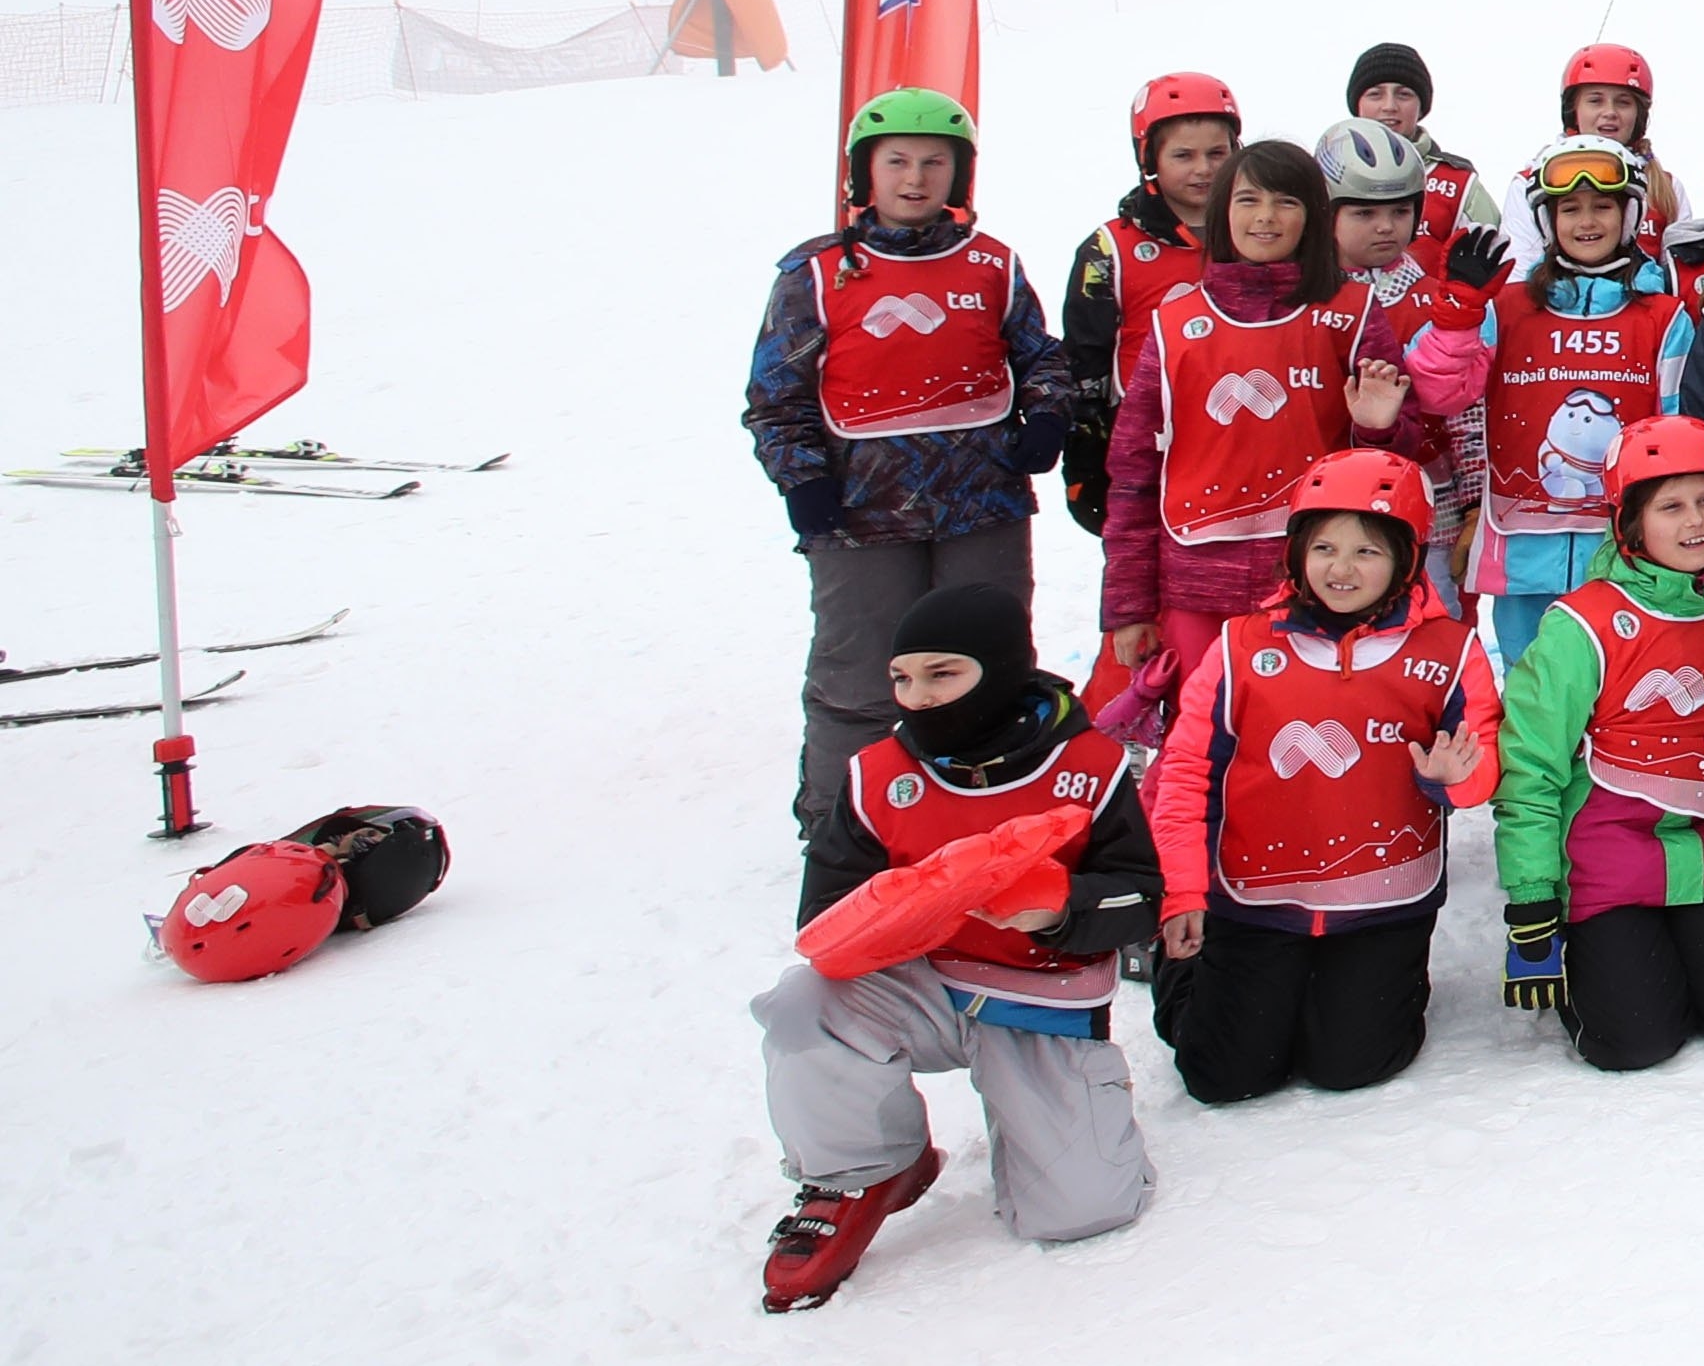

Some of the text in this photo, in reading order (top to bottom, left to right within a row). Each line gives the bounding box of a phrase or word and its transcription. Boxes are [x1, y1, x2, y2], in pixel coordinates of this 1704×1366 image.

[1426, 177, 1457, 198] 843
[1416, 220, 1431, 236] el
[1640, 219, 1657, 237] el
[946, 291, 987, 311] tel
[1311, 309, 1355, 332] 1457
[1550, 330, 1620, 355] 1455
[1288, 366, 1324, 390] tel
[1503, 365, 1651, 386] Карай внимателно!
[1403, 657, 1450, 686] 1475
[1053, 770, 1099, 803] 881
